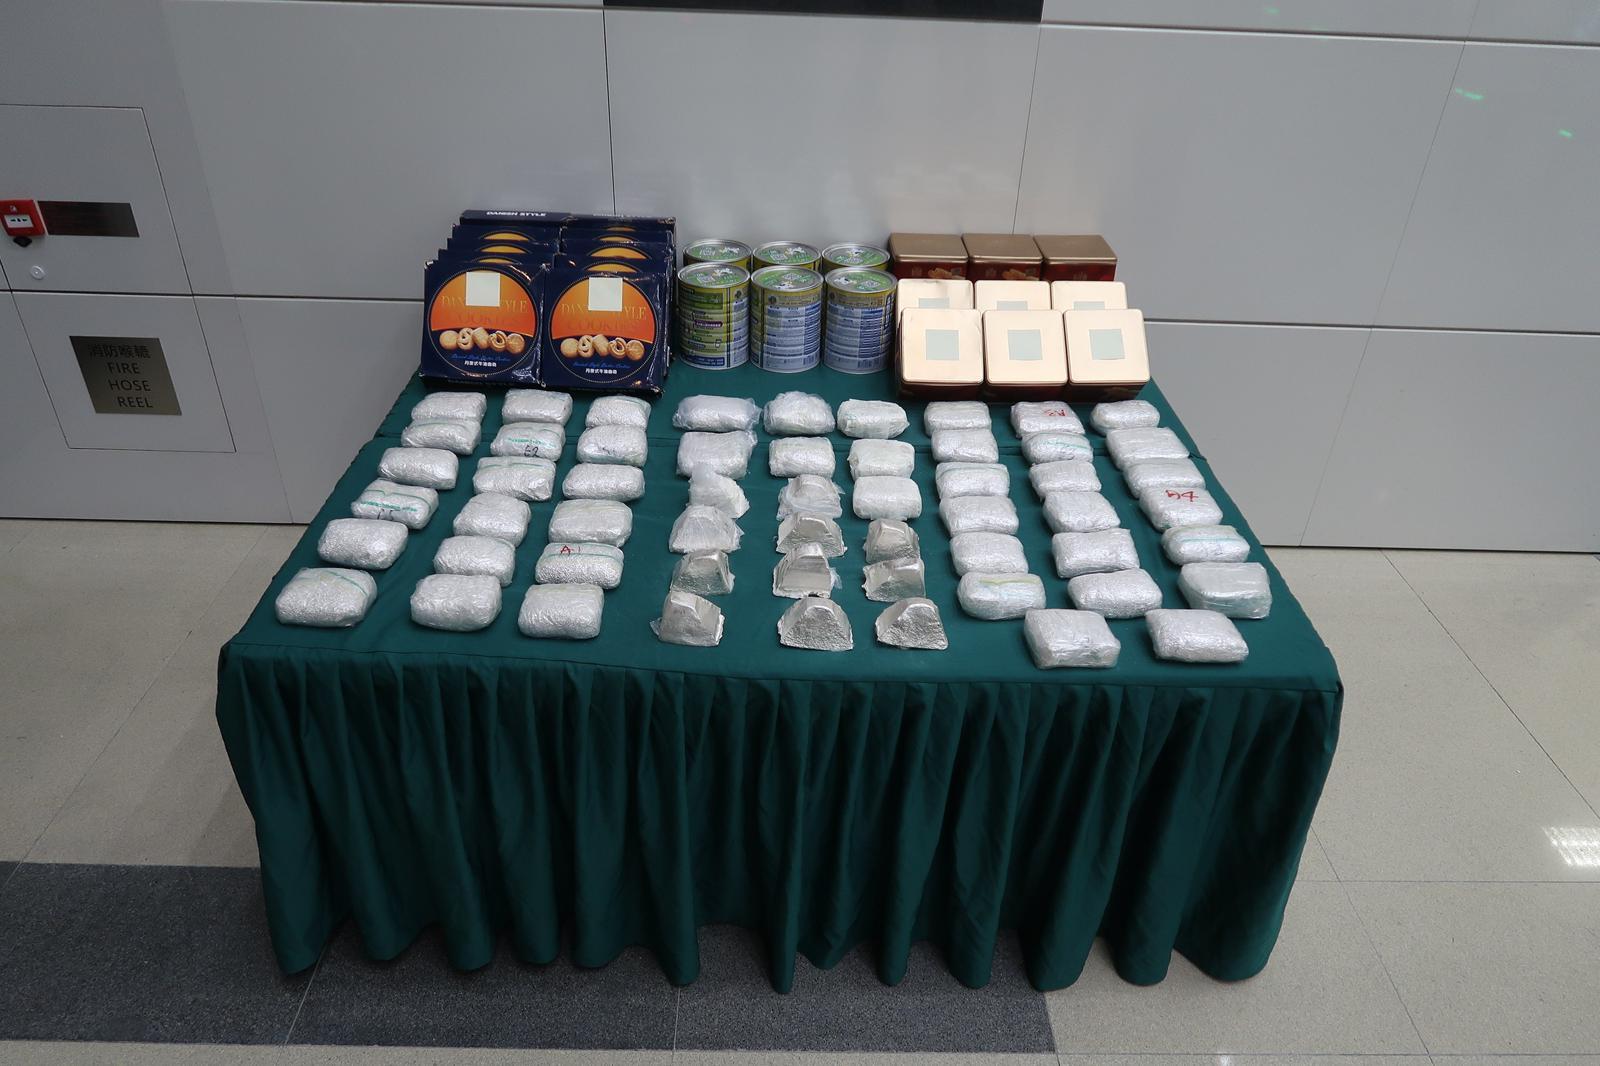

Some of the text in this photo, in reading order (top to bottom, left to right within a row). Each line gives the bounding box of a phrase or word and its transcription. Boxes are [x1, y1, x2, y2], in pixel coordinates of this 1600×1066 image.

[107, 362, 140, 374] FIRE
[108, 379, 151, 392] HOSE
[117, 396, 153, 408] REEL
